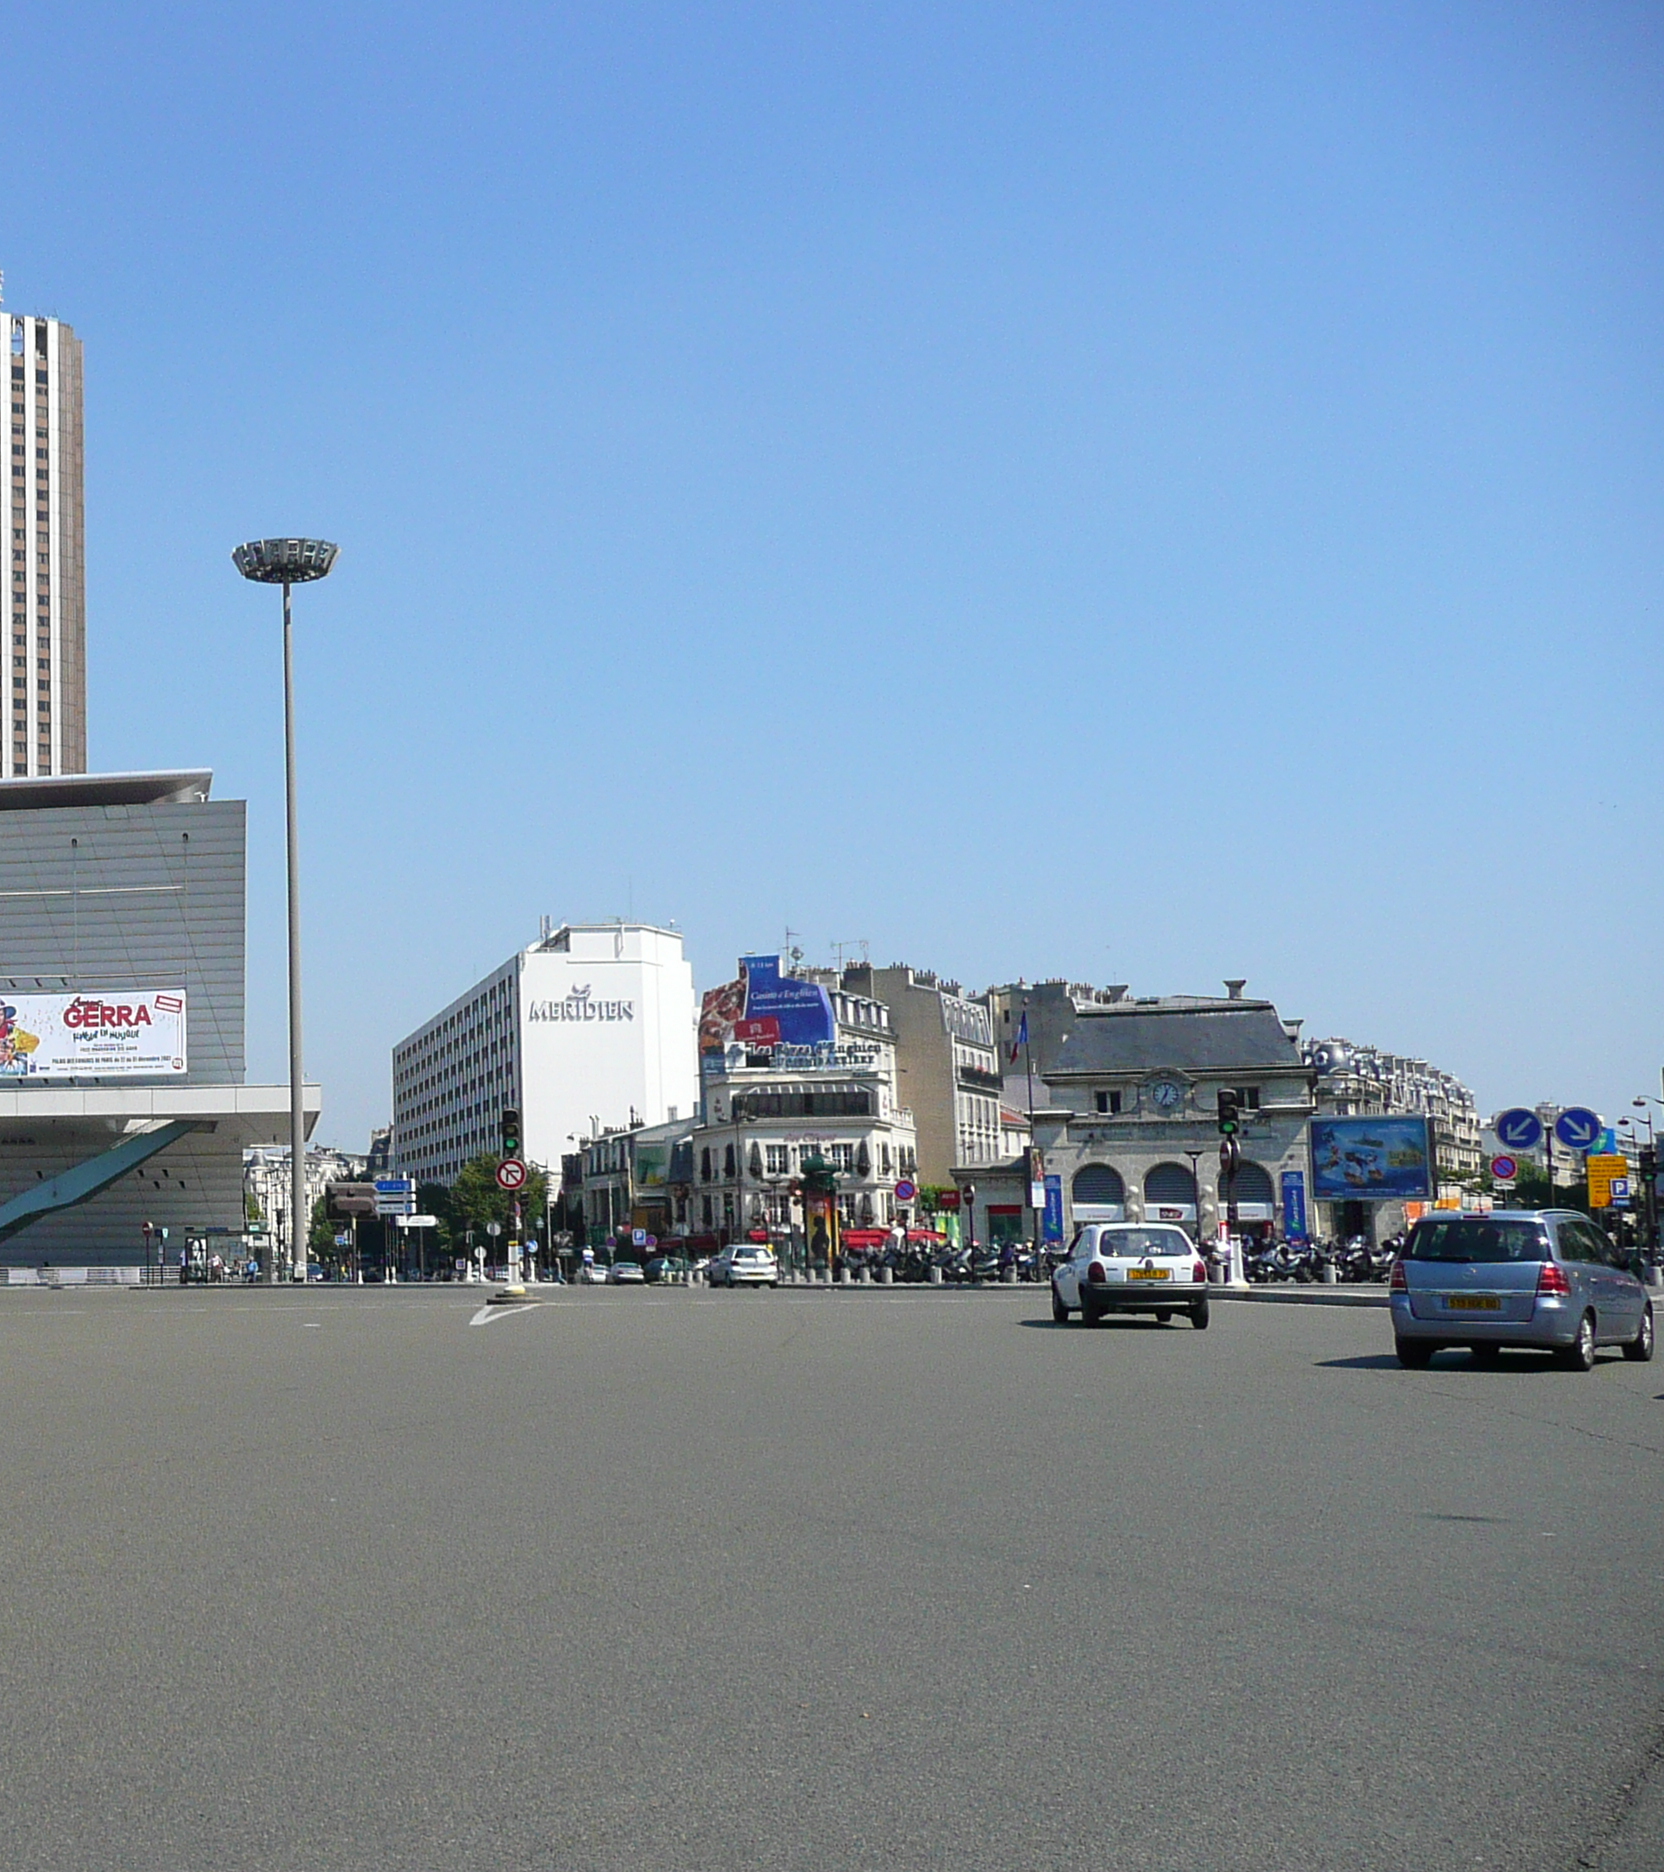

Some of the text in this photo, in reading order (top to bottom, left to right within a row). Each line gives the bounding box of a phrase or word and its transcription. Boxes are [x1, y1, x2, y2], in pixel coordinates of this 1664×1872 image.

[63, 1004, 152, 1028] GERRA
[528, 1000, 635, 1022] MERIDIEN
[1615, 1181, 1625, 1194] P
